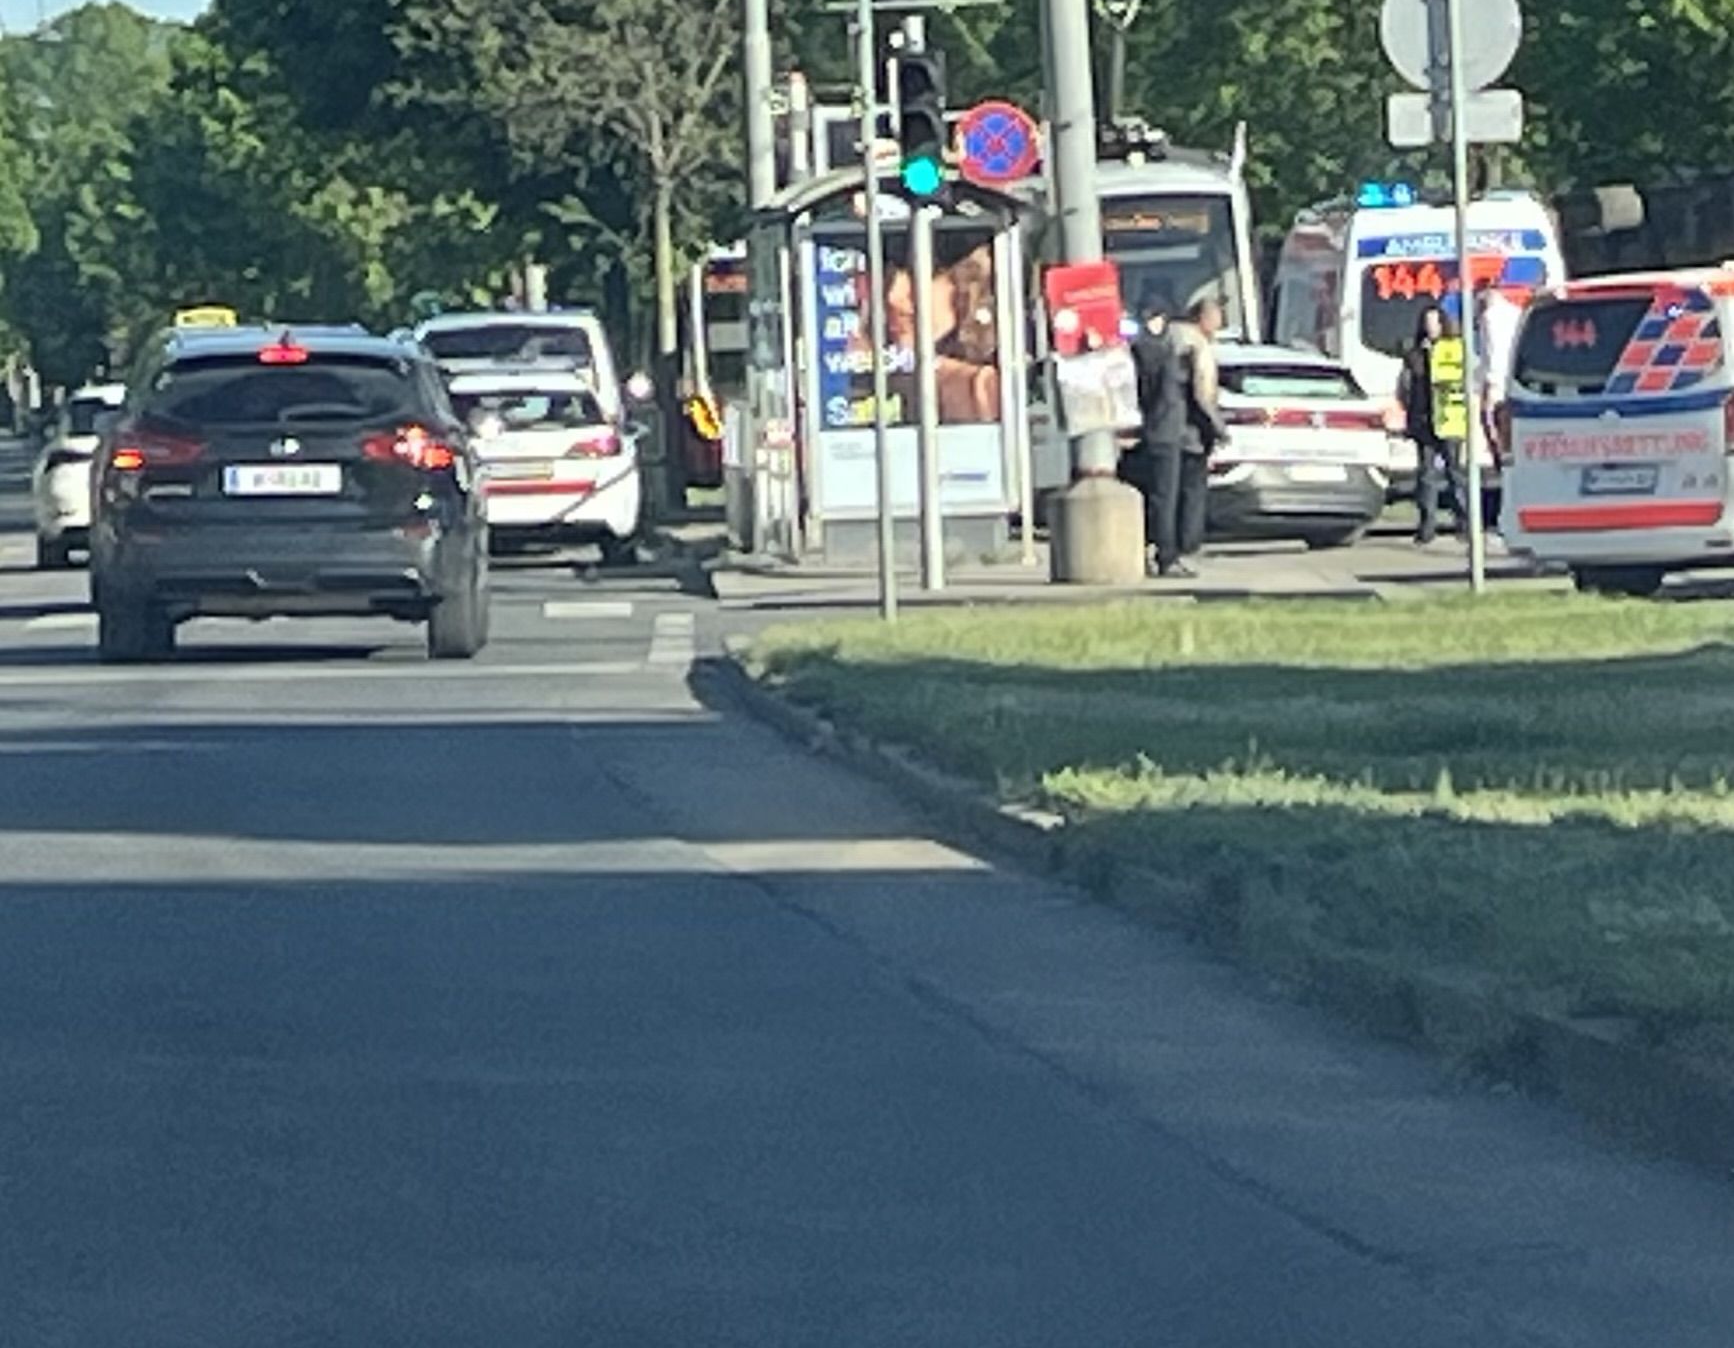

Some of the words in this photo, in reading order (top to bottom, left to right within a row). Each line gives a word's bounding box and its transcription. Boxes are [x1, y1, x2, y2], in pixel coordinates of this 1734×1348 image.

[1385, 231, 1525, 255] AMBANCE
[1374, 263, 1443, 300] 144
[1552, 318, 1596, 348] 144
